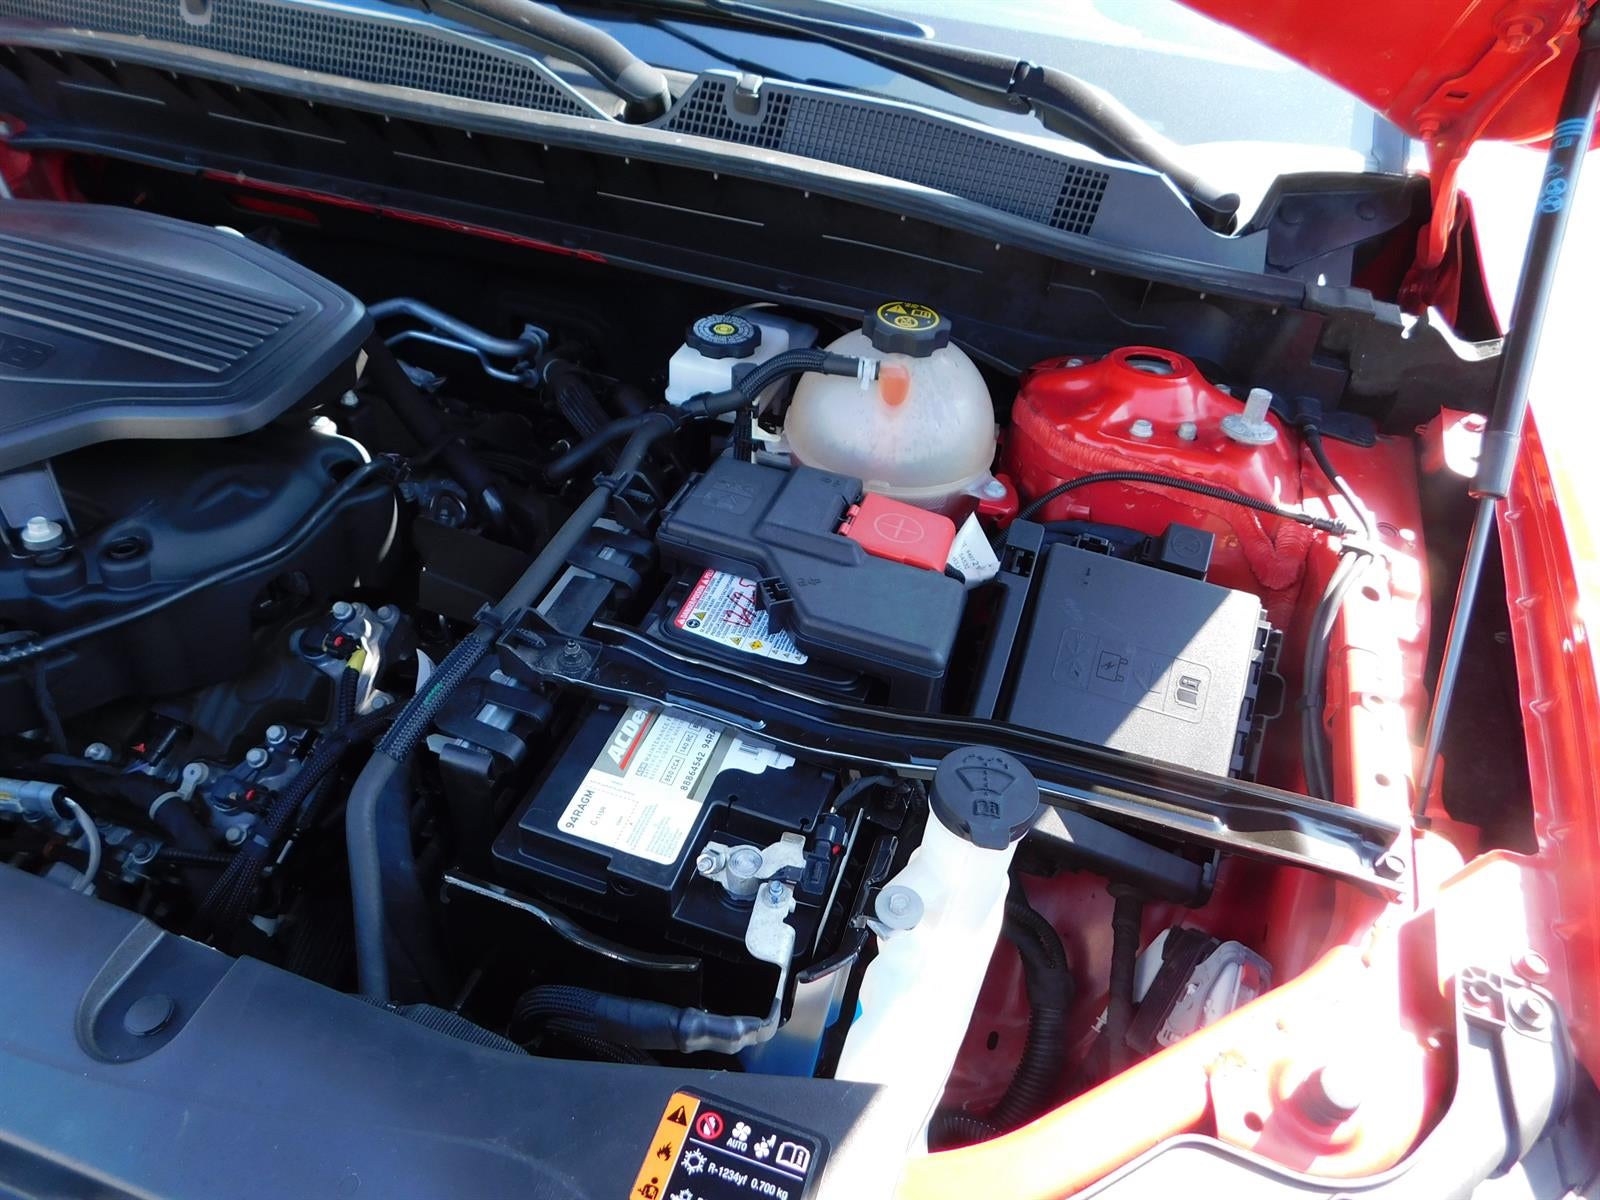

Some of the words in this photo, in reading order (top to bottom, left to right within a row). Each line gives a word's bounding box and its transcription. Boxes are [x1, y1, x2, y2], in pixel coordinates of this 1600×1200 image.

[670, 757, 681, 770] CCA
[565, 789, 594, 828] 94RAGM
[727, 1138, 747, 1152] AUTO
[707, 1163, 748, 1185] R-1234yf
[751, 1178, 776, 1194] 0.700
[776, 1185, 788, 1200] kg
